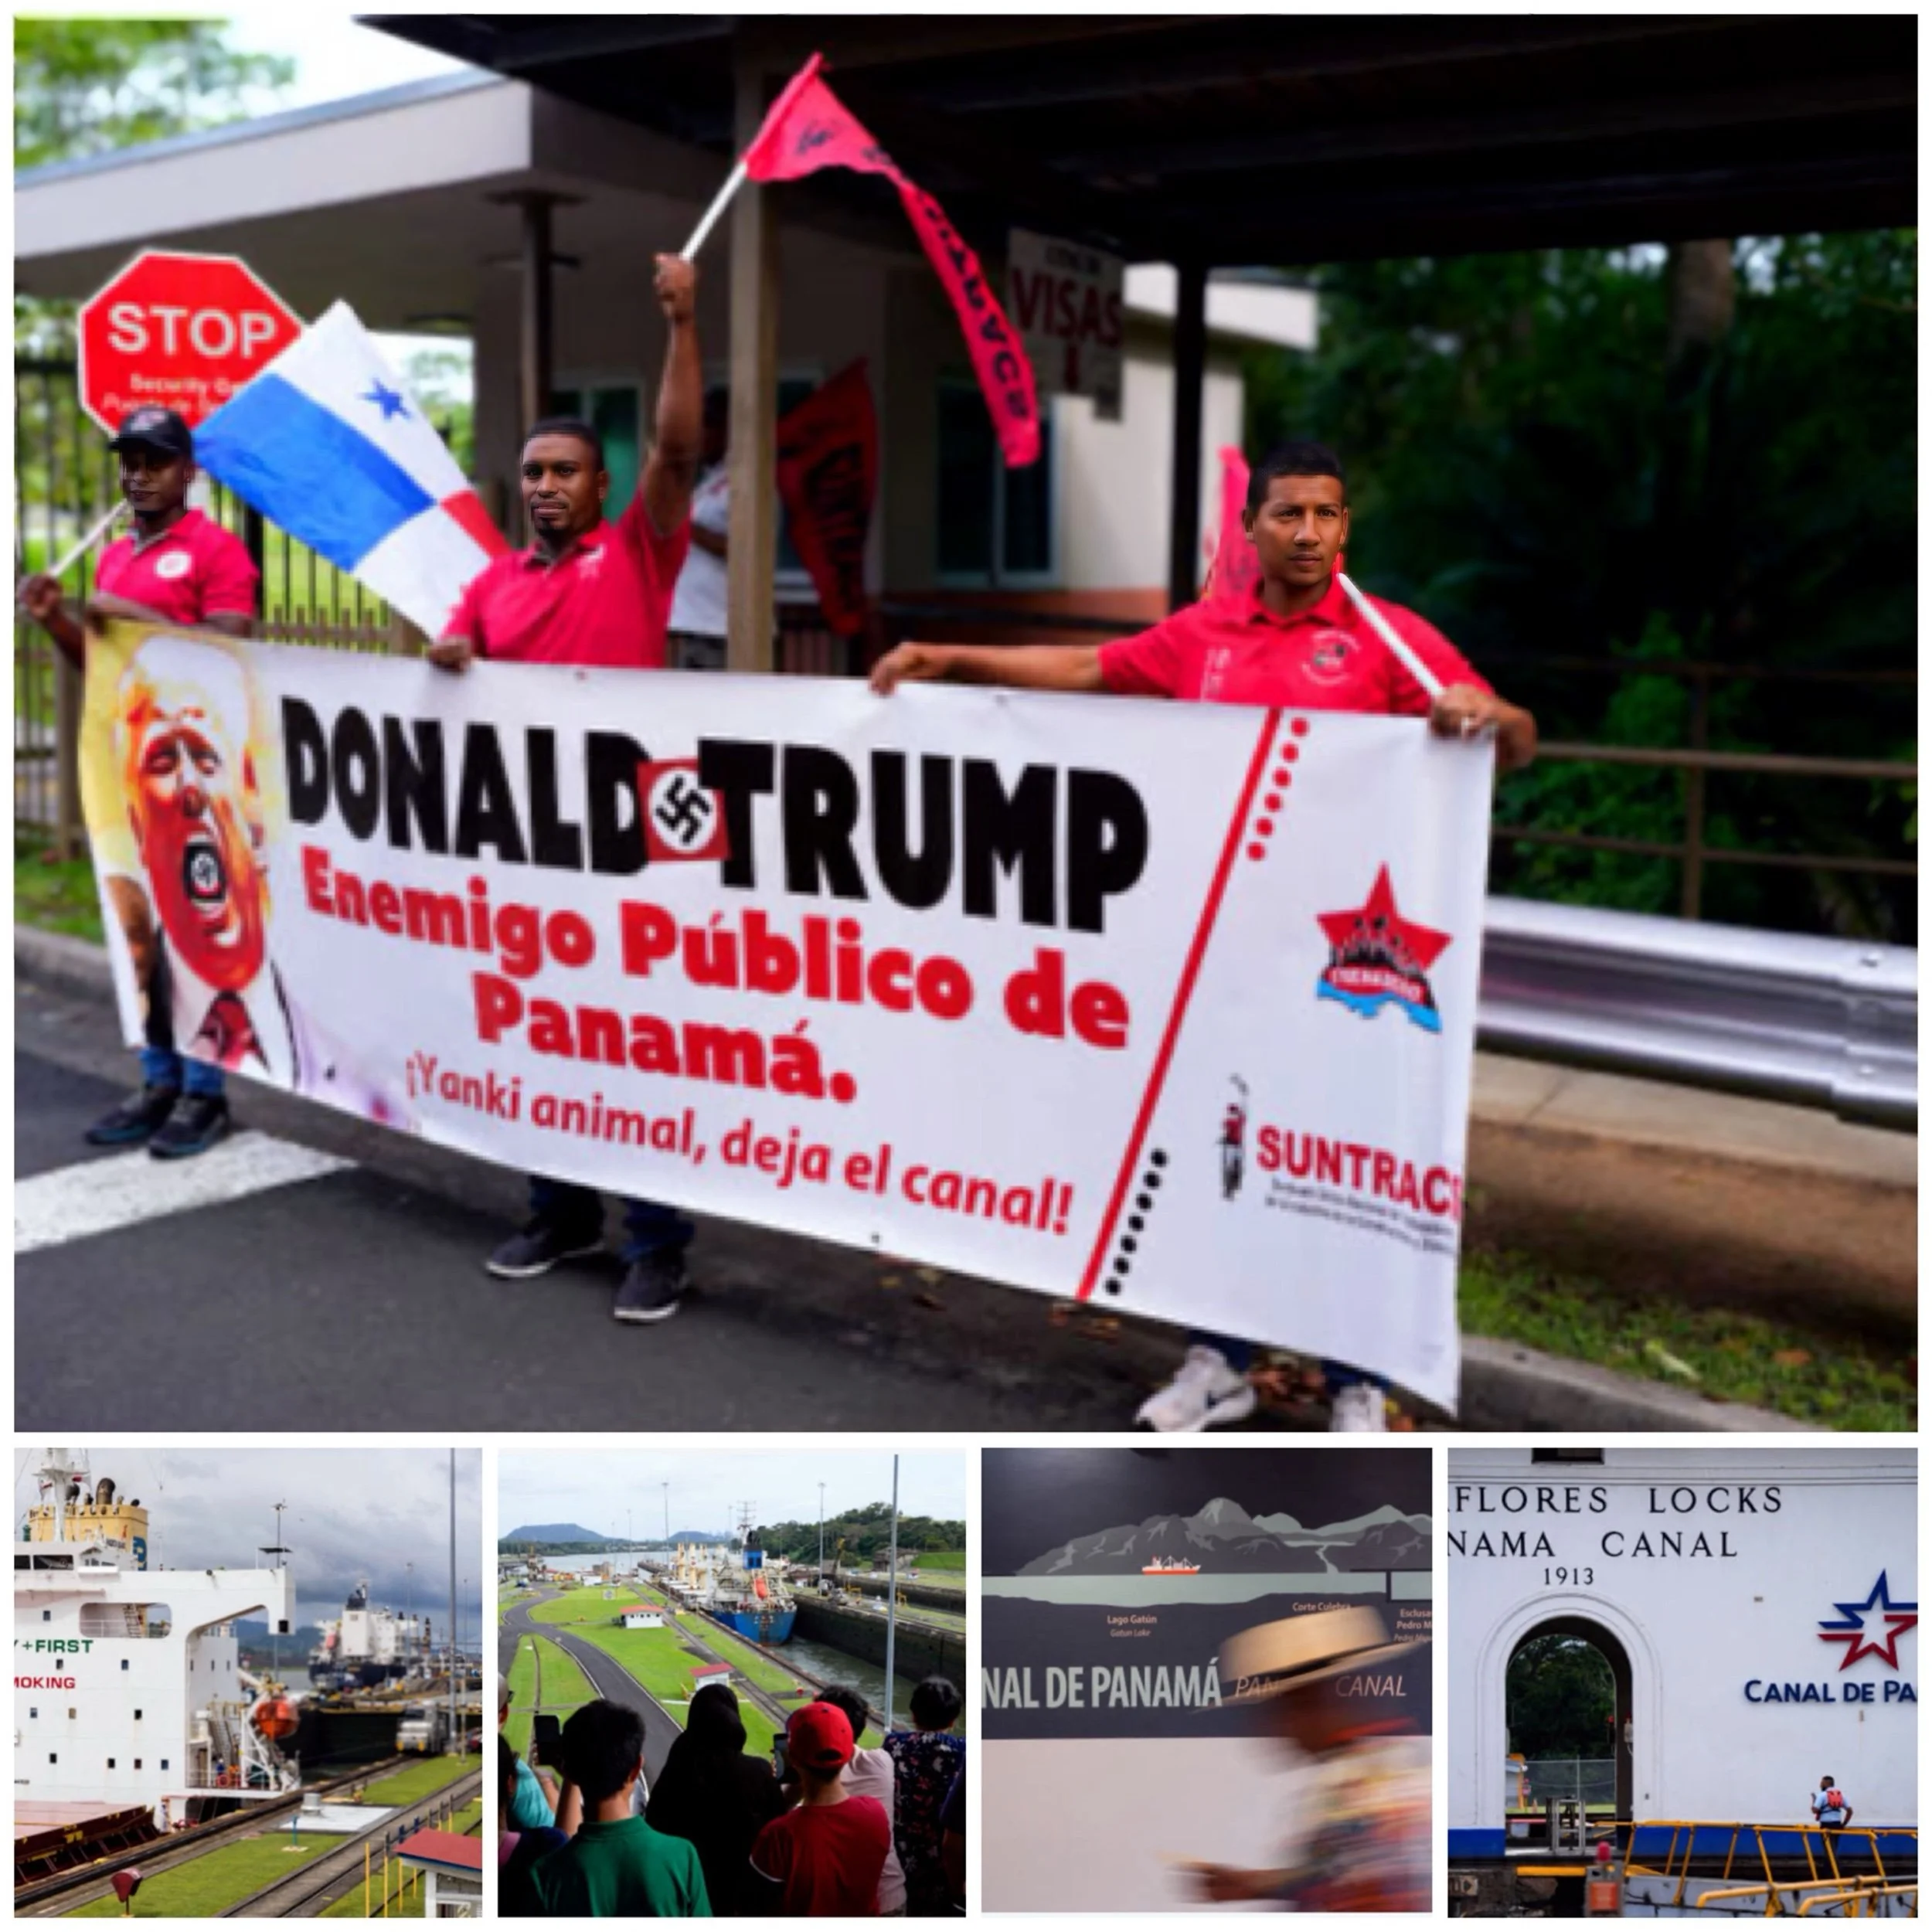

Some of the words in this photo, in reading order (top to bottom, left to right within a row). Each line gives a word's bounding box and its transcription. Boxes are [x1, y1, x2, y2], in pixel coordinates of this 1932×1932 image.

[1011, 267, 1122, 349] VISAS
[108, 304, 276, 357] STOP
[281, 695, 653, 876] DONALD
[697, 736, 1148, 933] TRUMP
[301, 843, 596, 978] Enemigo
[620, 899, 974, 1020] Público
[1003, 945, 1131, 1049] de
[472, 971, 857, 1103] Panamá.
[406, 1049, 523, 1121] ¡Yanki
[531, 1091, 708, 1165] animal,
[719, 1118, 831, 1188] deja
[844, 1143, 893, 1196] el
[901, 1175, 1074, 1236] canal!
[1448, 1485, 1608, 1513] FLORES
[1648, 1486, 1782, 1514] LOCKS
[1447, 1530, 1556, 1557] NAMA
[1601, 1531, 1738, 1558] CANAL
[1543, 1566, 1594, 1585] 1913
[1107, 1614, 1129, 1626] Lago
[1130, 1613, 1158, 1624] Gatún
[1292, 1601, 1317, 1612] Corte
[1396, 1620, 1422, 1630] Pedro
[981, 1666, 1039, 1709] NAL
[1046, 1666, 1084, 1709] DE
[1091, 1656, 1223, 1708] PANAMÁ
[1335, 1675, 1407, 1697] CANAL
[1743, 1679, 1836, 1703] CANAL
[1842, 1682, 1876, 1703] DE
[1883, 1680, 1918, 1703] PA
